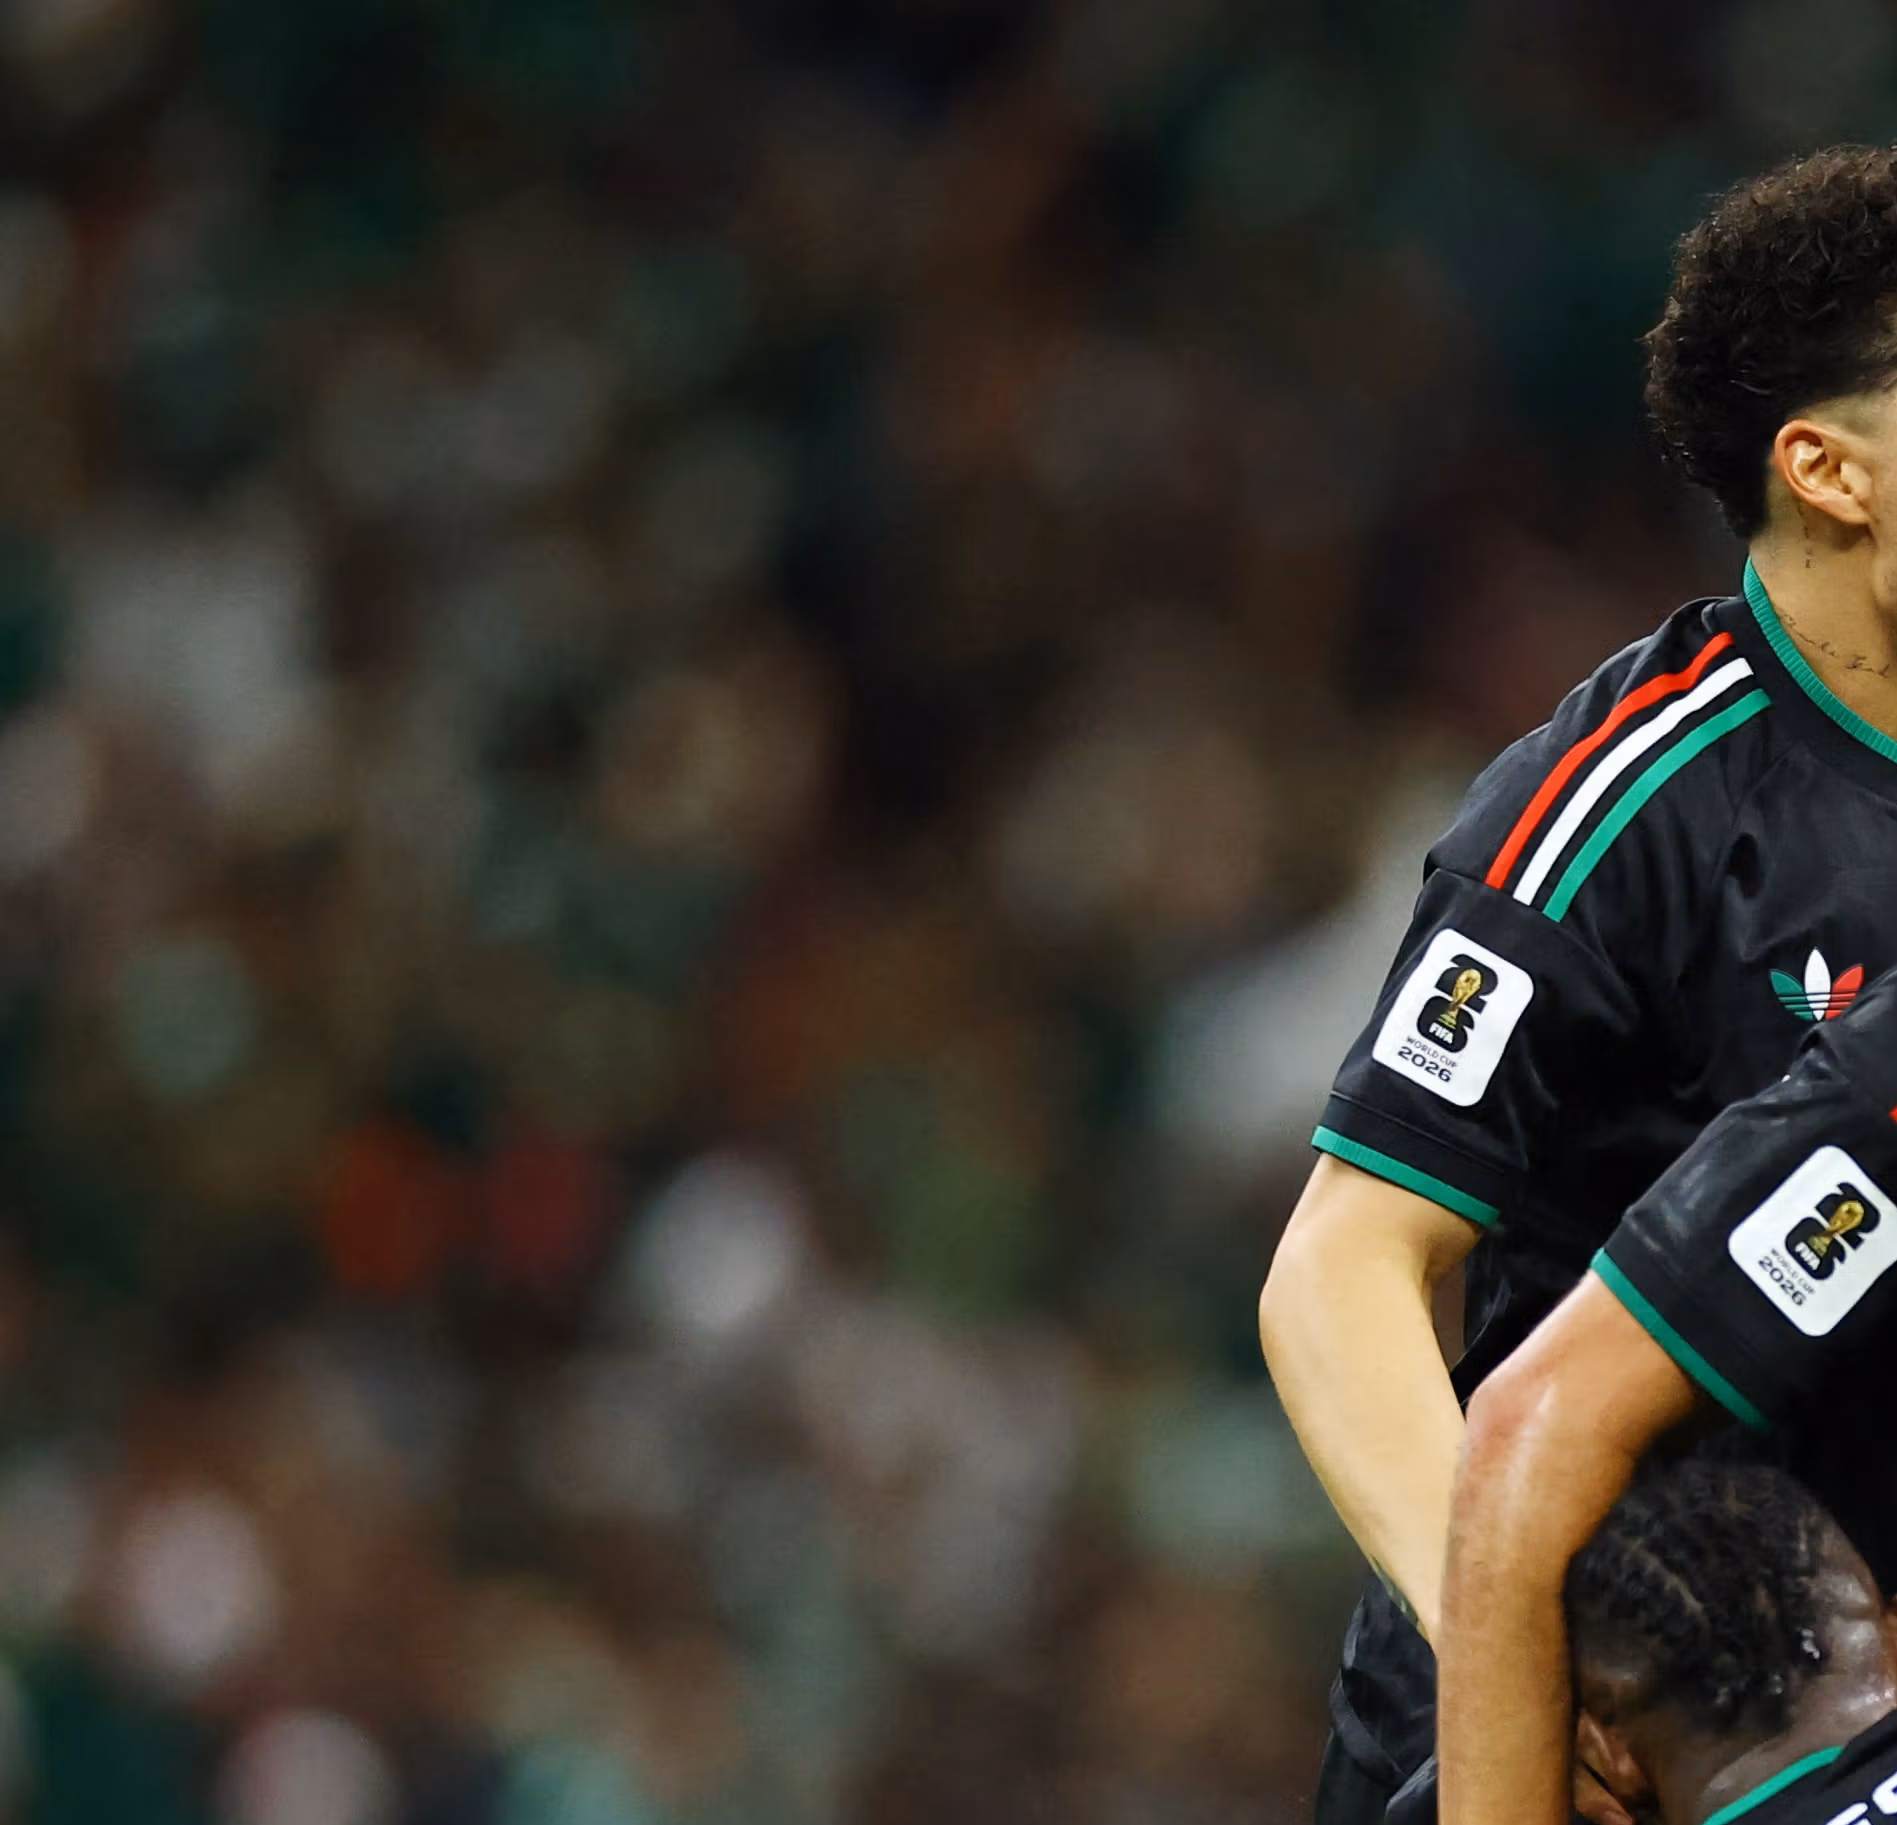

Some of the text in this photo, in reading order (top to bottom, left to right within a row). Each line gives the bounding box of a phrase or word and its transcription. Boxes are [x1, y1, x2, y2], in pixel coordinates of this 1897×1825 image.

[1428, 1022, 1454, 1044] FIFA
[1397, 1046, 1453, 1083] 2026
[1406, 1036, 1459, 1068] WORLD CUP
[1757, 1256, 1807, 1307] 2026
